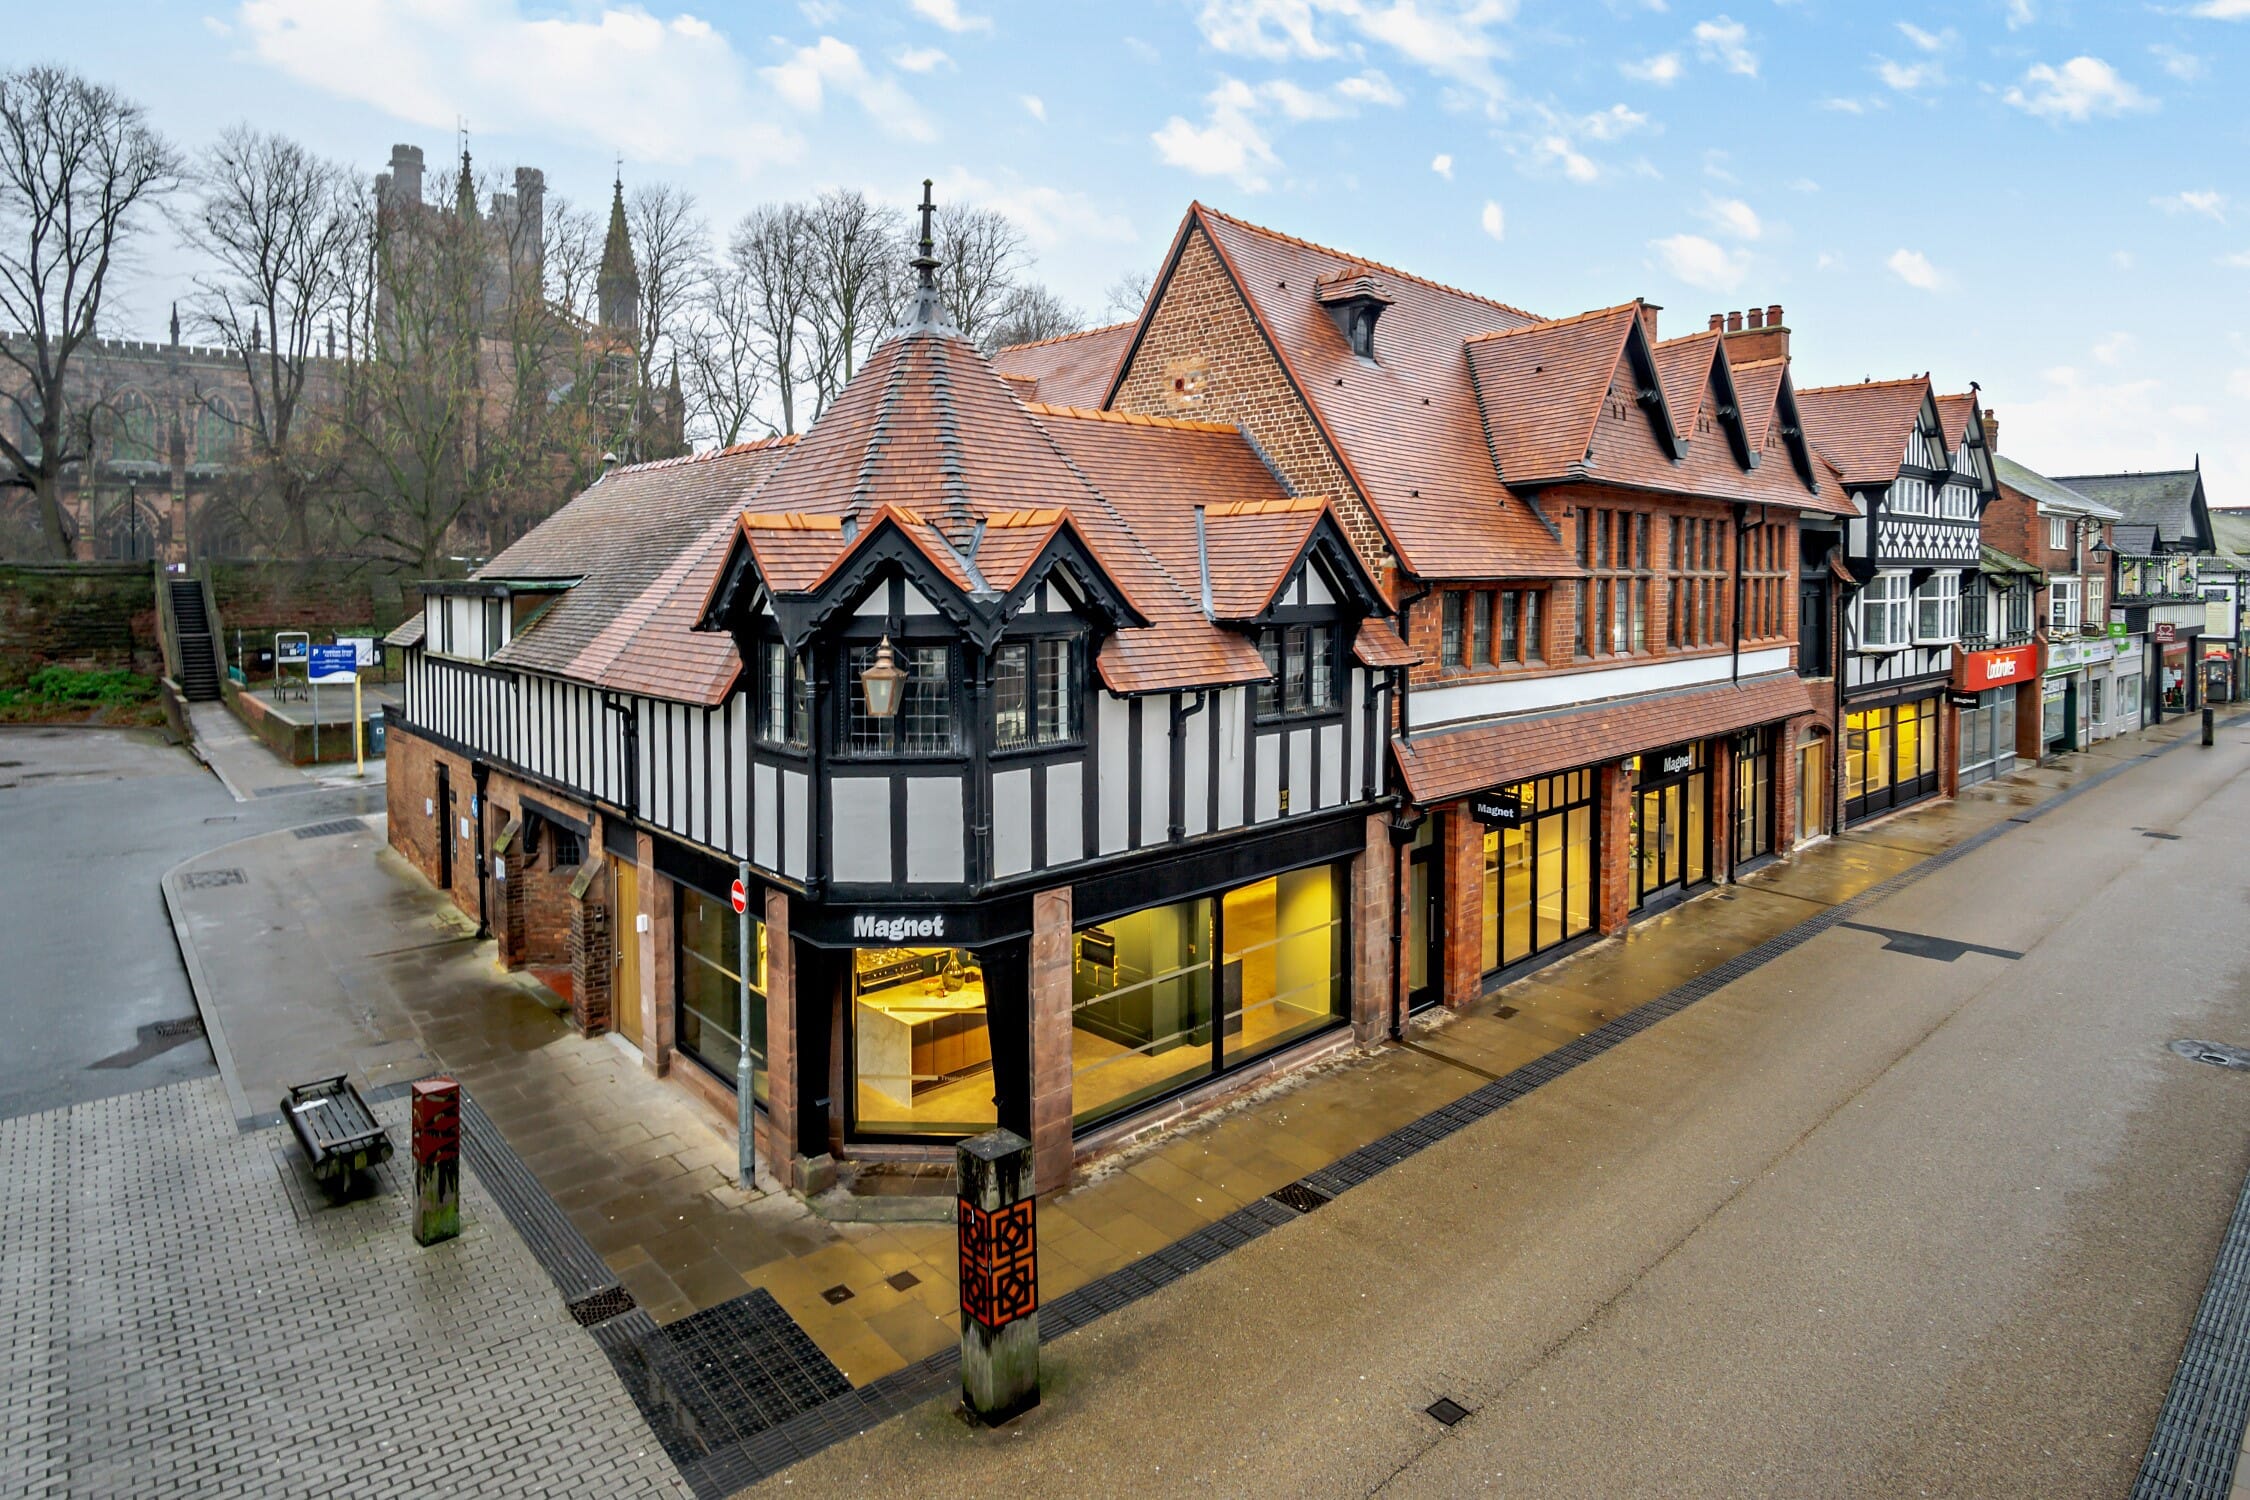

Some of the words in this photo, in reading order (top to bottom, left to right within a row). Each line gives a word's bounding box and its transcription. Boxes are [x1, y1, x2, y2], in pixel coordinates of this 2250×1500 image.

[1664, 752, 1692, 772] Magnet
[1477, 803, 1514, 818] Magnet
[853, 915, 944, 941] Magnet
